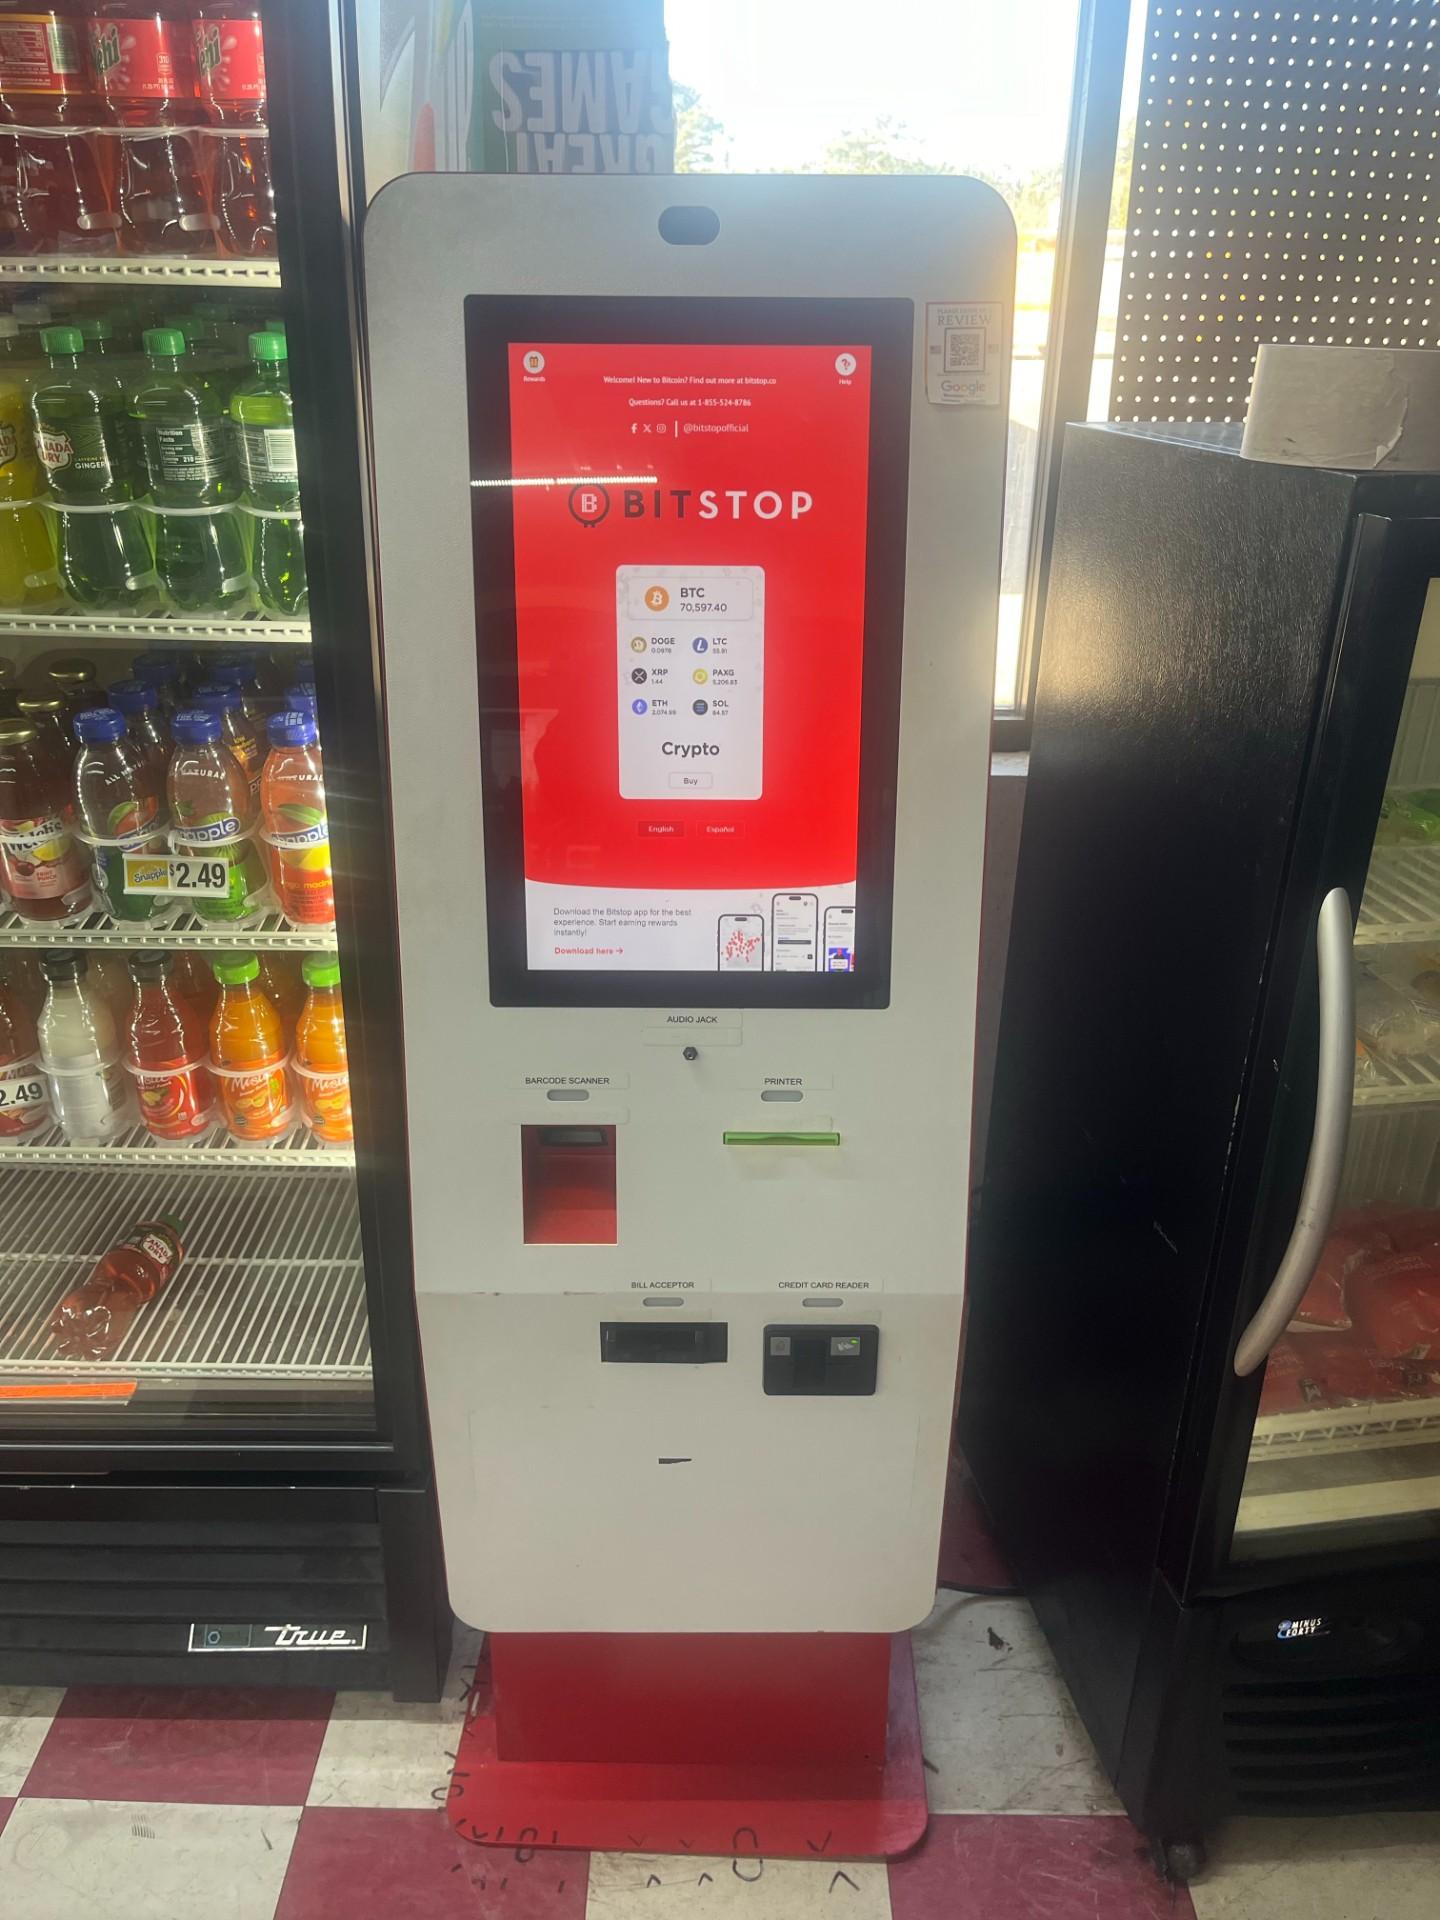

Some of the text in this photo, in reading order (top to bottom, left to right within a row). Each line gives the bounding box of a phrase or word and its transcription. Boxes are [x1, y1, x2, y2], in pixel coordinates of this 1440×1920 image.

[937, 314, 992, 326] REVIEW
[603, 375, 636, 384] Welcome!
[637, 376, 651, 384] New
[653, 376, 660, 384] to
[661, 376, 688, 385] Bitcoin?
[689, 376, 704, 385] Find
[705, 377, 717, 385] out
[744, 376, 777, 386] bitstop.co
[941, 380, 986, 395] Google
[628, 398, 665, 407] Questions?
[666, 398, 679, 407] Call
[680, 399, 688, 407] us
[689, 399, 696, 407] at
[683, 422, 749, 434] @bitstopofficial
[623, 489, 813, 520] BITSTOP
[680, 587, 705, 598] BTC
[680, 603, 728, 613] 70,597.40
[651, 637, 676, 645] DOGE
[712, 637, 728, 645] LTC
[651, 668, 669, 676] XRP
[712, 669, 735, 677] PAXG
[652, 699, 668, 707] ETH
[712, 700, 729, 708] SOL
[661, 741, 720, 758] Crypto
[683, 776, 698, 786] Buy
[648, 825, 675, 834] English
[706, 825, 735, 834] Español
[169, 862, 226, 888] $2.49
[553, 908, 692, 917] Download the Bitstop app for the best
[553, 919, 595, 927] experience.
[598, 918, 617, 926] Start
[618, 919, 647, 928] earning
[553, 929, 587, 937] instantly!
[554, 947, 614, 955] Download here
[667, 1015, 718, 1024] AUDIO JACK
[525, 1076, 610, 1085] BARCODE SCANNER
[764, 1077, 803, 1086] PRINTER
[631, 1281, 695, 1289] BILL ACCEPTOR
[778, 1281, 870, 1289] CREDIT CARD READER
[1291, 1618, 1321, 1628] MINUS
[1286, 1627, 1315, 1637] FORTY
